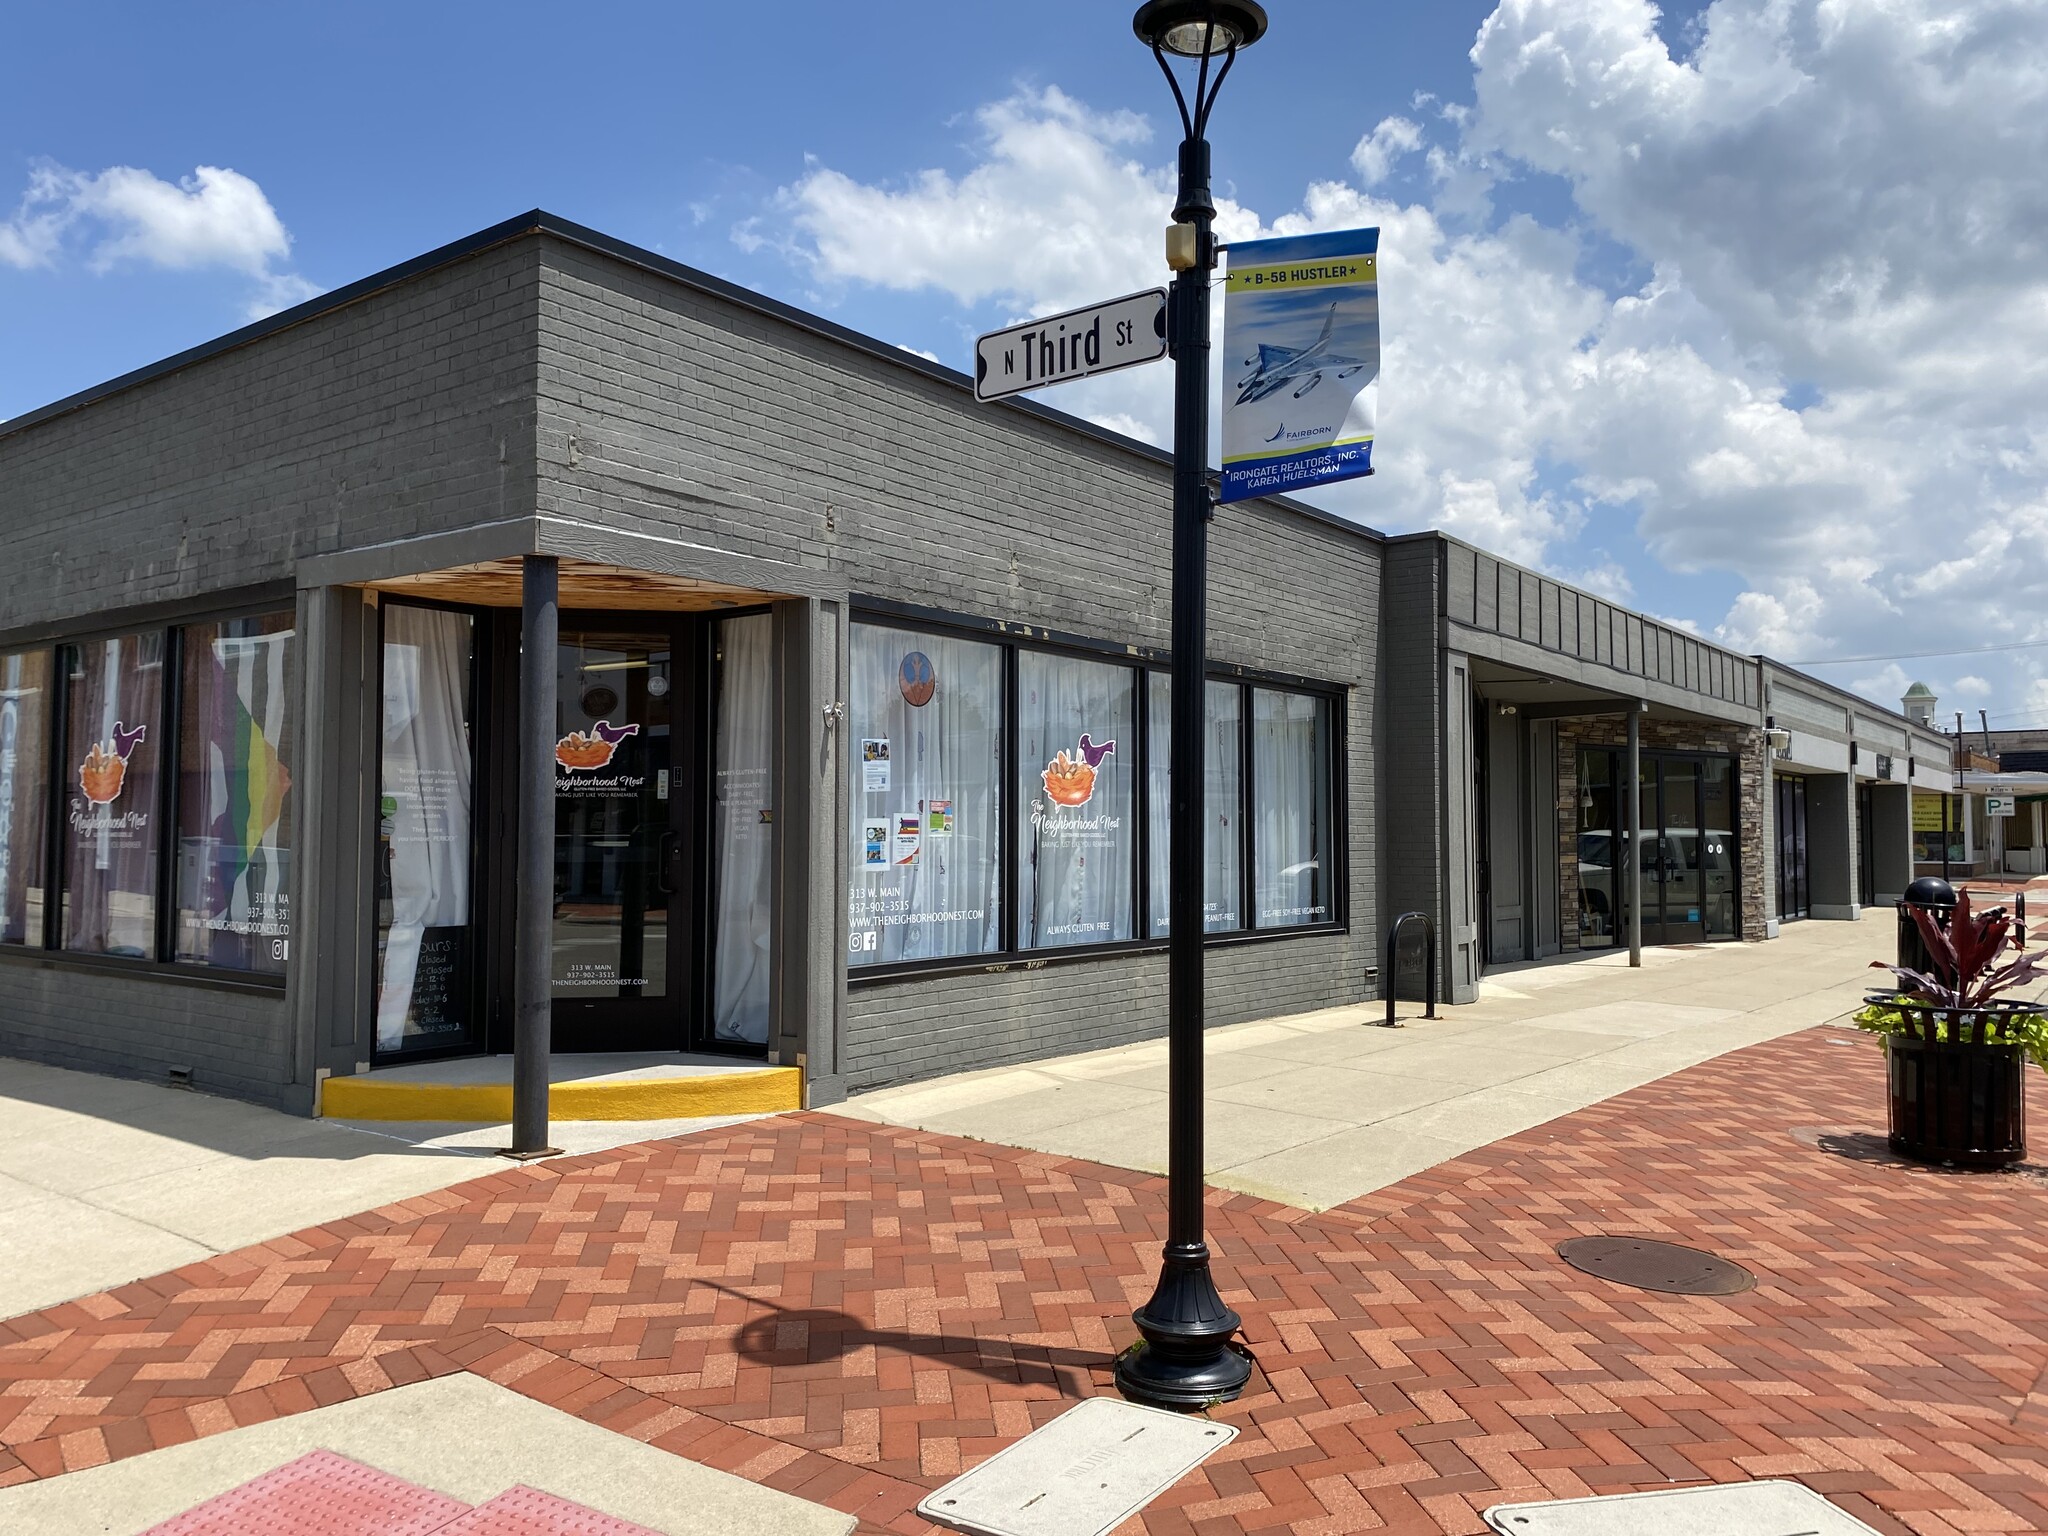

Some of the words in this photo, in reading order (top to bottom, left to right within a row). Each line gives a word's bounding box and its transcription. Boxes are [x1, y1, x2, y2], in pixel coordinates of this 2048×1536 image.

[1255, 271, 1287, 285] B-58
[1290, 266, 1347, 281] HUSTLER
[1004, 349, 1014, 375] N
[1021, 314, 1100, 381] Third
[1116, 319, 1133, 347] St
[1286, 426, 1332, 439] FAIRBORN
[1230, 465, 1278, 482] IRONGATE
[1280, 455, 1334, 472] REALTORS,
[1337, 450, 1359, 462] INC.
[1247, 475, 1280, 489] KAREN
[1282, 463, 1340, 483] HUELSMAN
[619, 775, 646, 787] Nest
[1030, 799, 1045, 813] The
[128, 811, 148, 830] Nest
[1030, 812, 1099, 837] Neighborhood
[1099, 814, 1120, 831] Nest
[1041, 840, 1060, 848] BAKING
[278, 893, 289, 905] MA
[849, 888, 865, 898] 313
[867, 887, 877, 898] W.
[880, 886, 901, 897] MAIN
[247, 906, 289, 920] 937-902-351
[849, 900, 909, 913] 937-902-3515
[849, 909, 984, 928] WWW.THENEIGHBORHOODNEST.COM
[1157, 917, 1169, 927] DAIR
[1204, 912, 1235, 923] PEANUT-FREE
[185, 918, 289, 935] WWW.THENEIGHBORHOODNEST.CO
[1047, 924, 1071, 935] ALWAYS
[1071, 922, 1095, 933] GLUTEN
[1096, 921, 1110, 931] FREE
[419, 940, 457, 953] ours:
[420, 955, 446, 964] Closed
[566, 971, 615, 979] 937-902-3515
